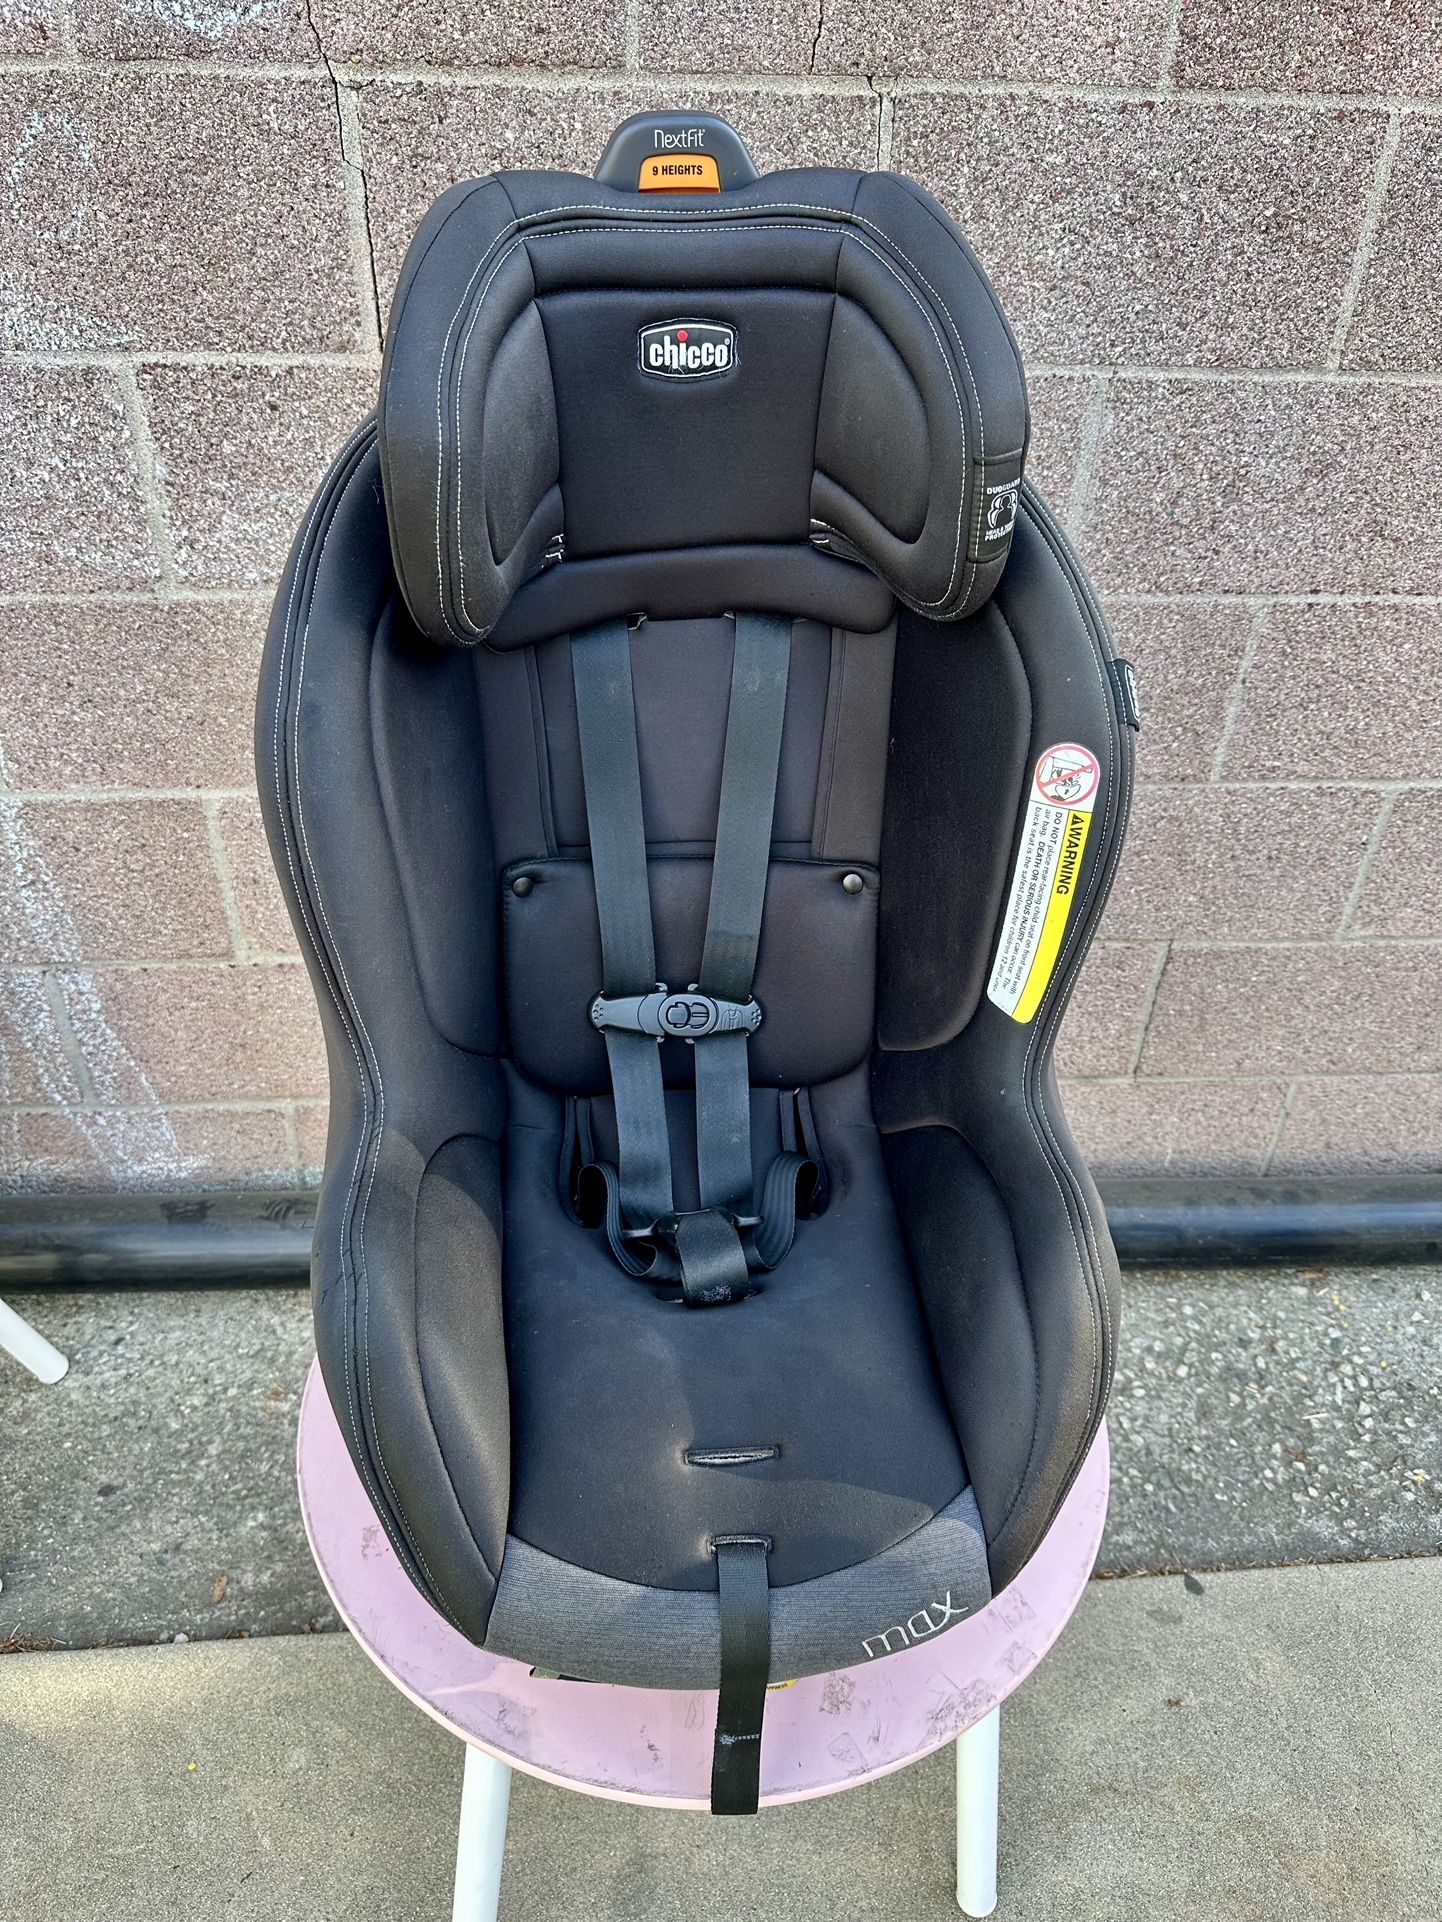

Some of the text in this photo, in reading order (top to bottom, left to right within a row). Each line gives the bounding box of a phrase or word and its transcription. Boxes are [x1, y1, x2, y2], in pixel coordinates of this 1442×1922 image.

[654, 129, 704, 148] NextFit
[652, 165, 703, 176] 9 HEIGHTS
[650, 328, 728, 369] chicco
[1032, 807, 1042, 827] back
[1055, 812, 1062, 824] DO
[1040, 821, 1050, 837] bag.
[1050, 827, 1059, 844] NOT
[1034, 841, 1045, 868] DEATH
[1056, 828, 1082, 894] WARNING
[1031, 869, 1039, 881] OR
[1035, 866, 1049, 905] rear-facing
[1014, 894, 1023, 914] place
[1024, 882, 1036, 915] SERIOUS
[1018, 915, 1028, 942] INJURY
[1004, 926, 1015, 954] children
[1025, 939, 1031, 948] on
[1002, 956, 1008, 965] 12
[1020, 950, 1030, 965] front
[862, 1590, 969, 1657] max
